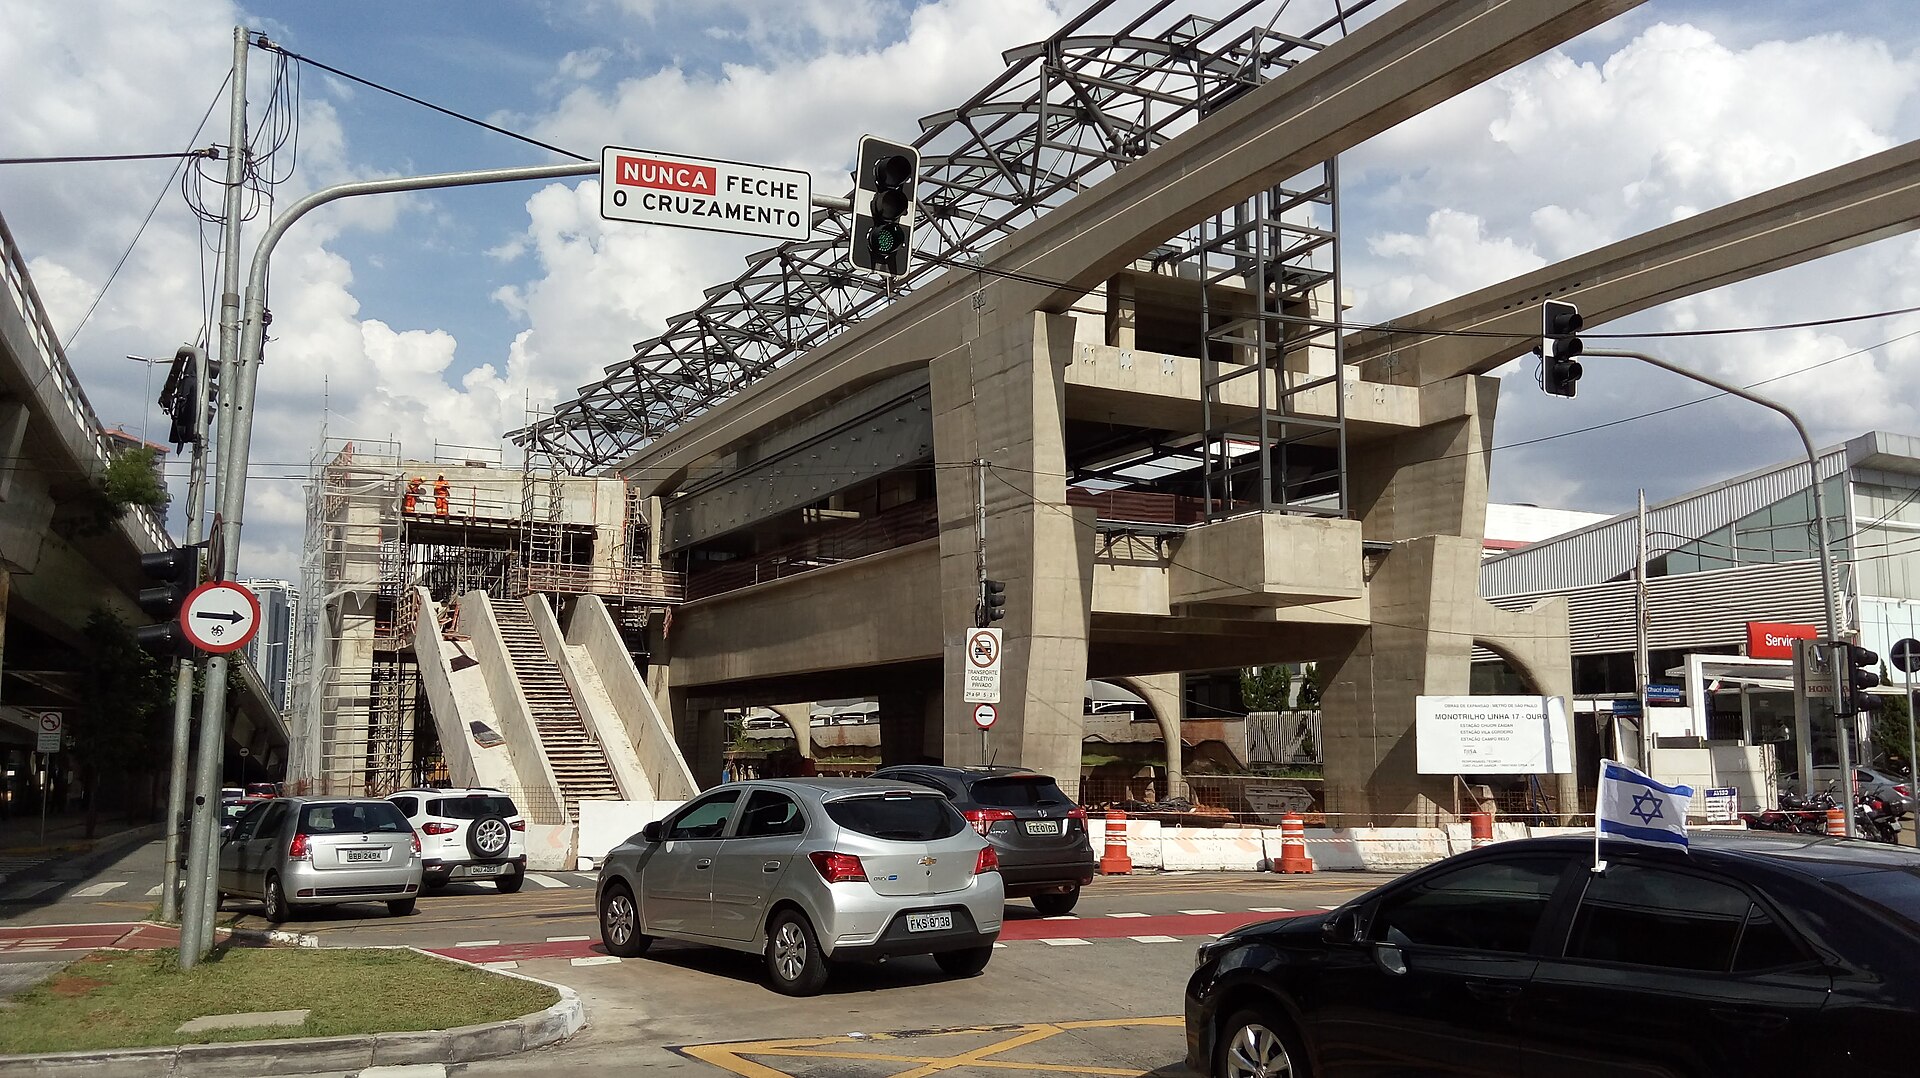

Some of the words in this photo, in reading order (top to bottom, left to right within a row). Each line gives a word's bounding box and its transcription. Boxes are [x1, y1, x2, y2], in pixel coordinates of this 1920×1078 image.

[624, 162, 708, 190] NUNCA
[726, 175, 798, 200] FECHE
[613, 189, 627, 207] O
[643, 193, 800, 228] CRUZAMENTO
[1808, 685, 1850, 694] HONA
